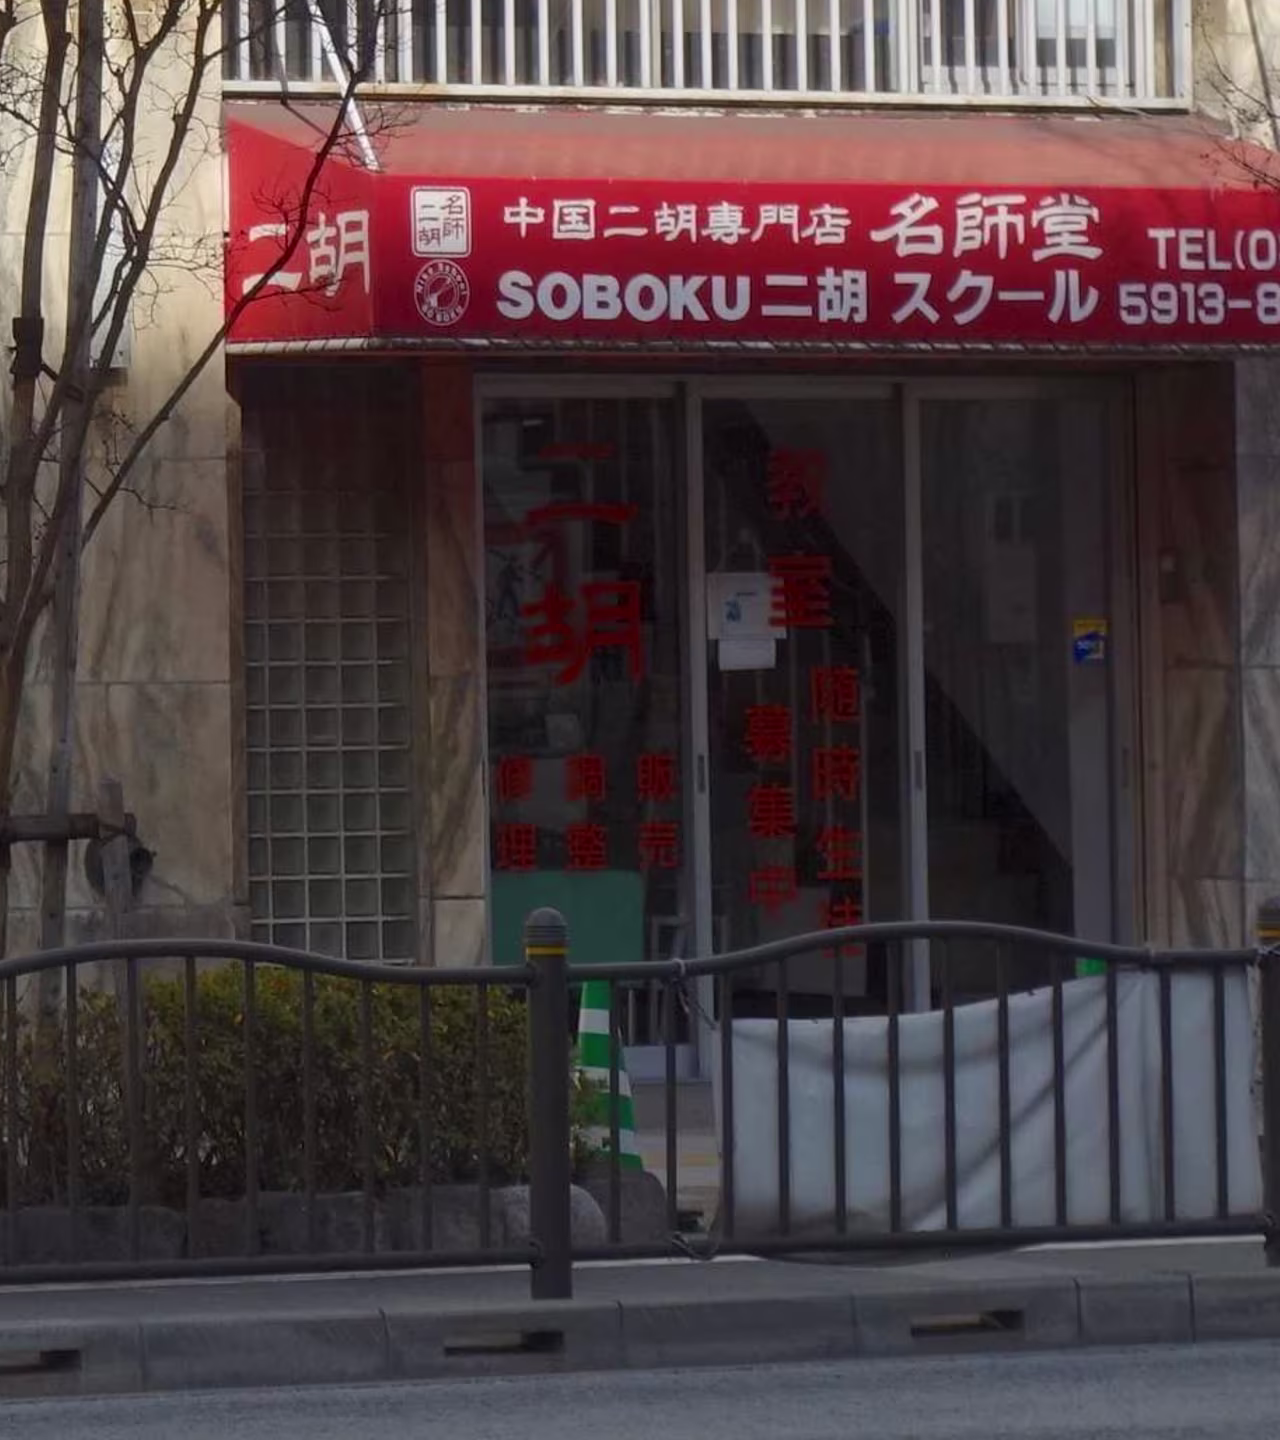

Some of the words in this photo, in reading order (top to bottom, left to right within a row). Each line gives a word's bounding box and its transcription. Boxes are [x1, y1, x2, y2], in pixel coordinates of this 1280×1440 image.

[242, 209, 370, 297] 二胡
[503, 196, 852, 246] 中国二胡専門店
[869, 192, 1104, 262] 名師堂
[1148, 228, 1280, 272] TEL(0
[891, 268, 1100, 325] スクール
[517, 440, 647, 686] 二胡
